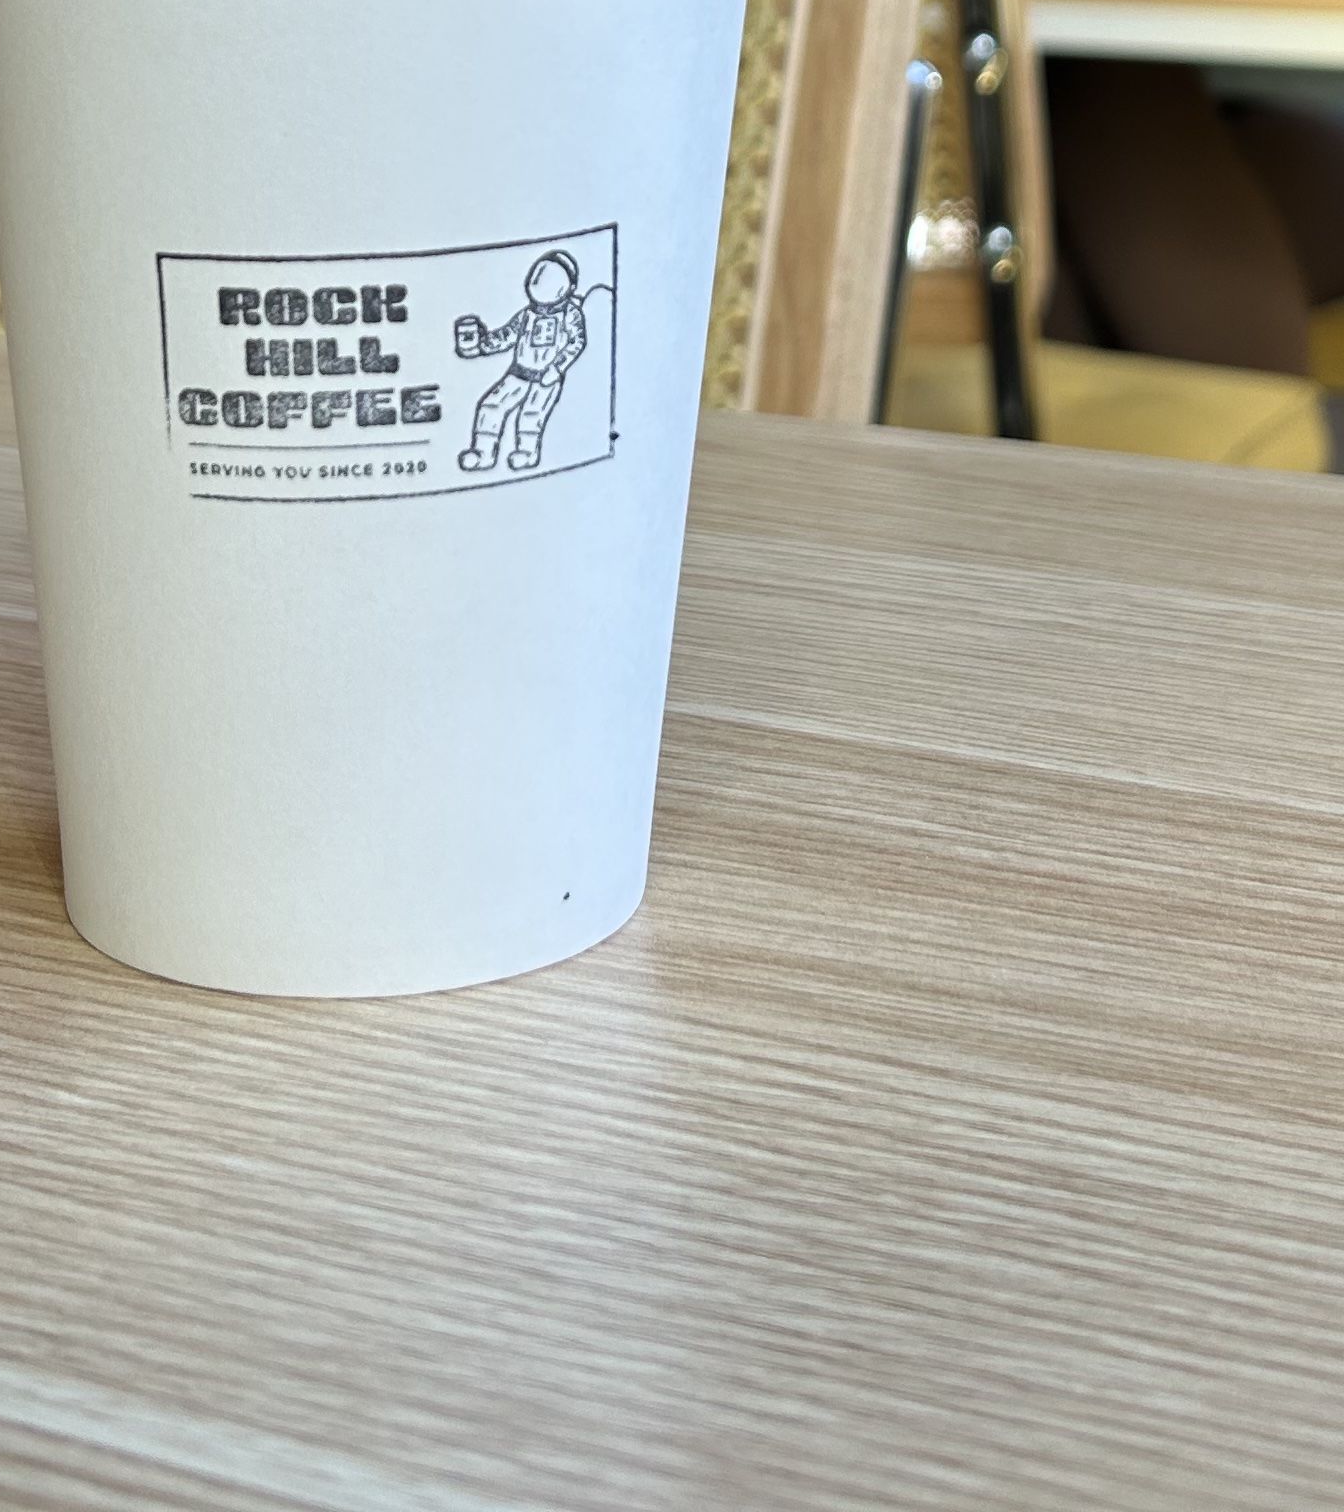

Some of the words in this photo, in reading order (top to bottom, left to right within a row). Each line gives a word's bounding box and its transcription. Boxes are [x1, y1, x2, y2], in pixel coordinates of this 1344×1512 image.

[217, 283, 408, 327] ROCK
[244, 336, 400, 377] HILL
[177, 383, 442, 431] COFFEE
[189, 461, 266, 479] SERVING
[272, 465, 313, 480] YOU
[318, 462, 374, 480] SINCE
[382, 458, 428, 477] 2020
